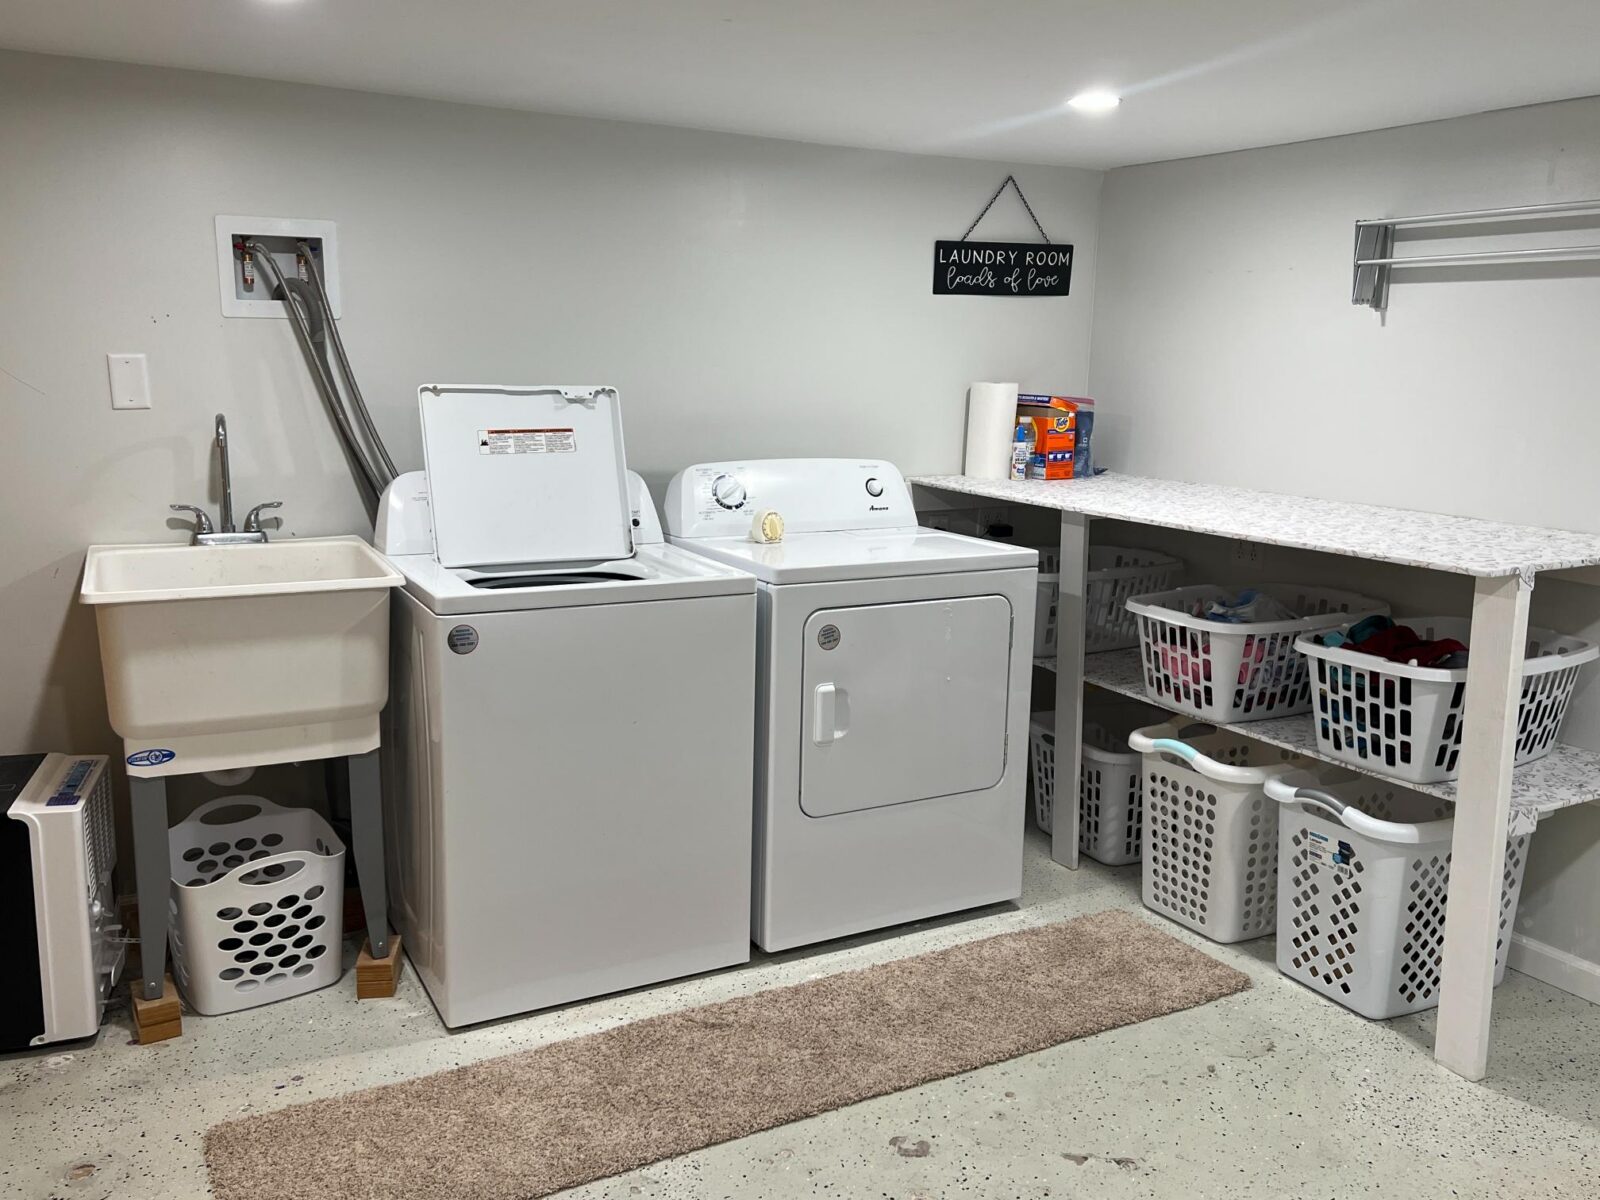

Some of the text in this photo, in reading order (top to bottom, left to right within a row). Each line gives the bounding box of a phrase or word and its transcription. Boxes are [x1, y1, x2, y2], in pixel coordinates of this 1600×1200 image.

[939, 249, 1070, 266] LAUNDRY ROOM
[947, 265, 1059, 293] loads of love
[1055, 416, 1069, 428] Tide
